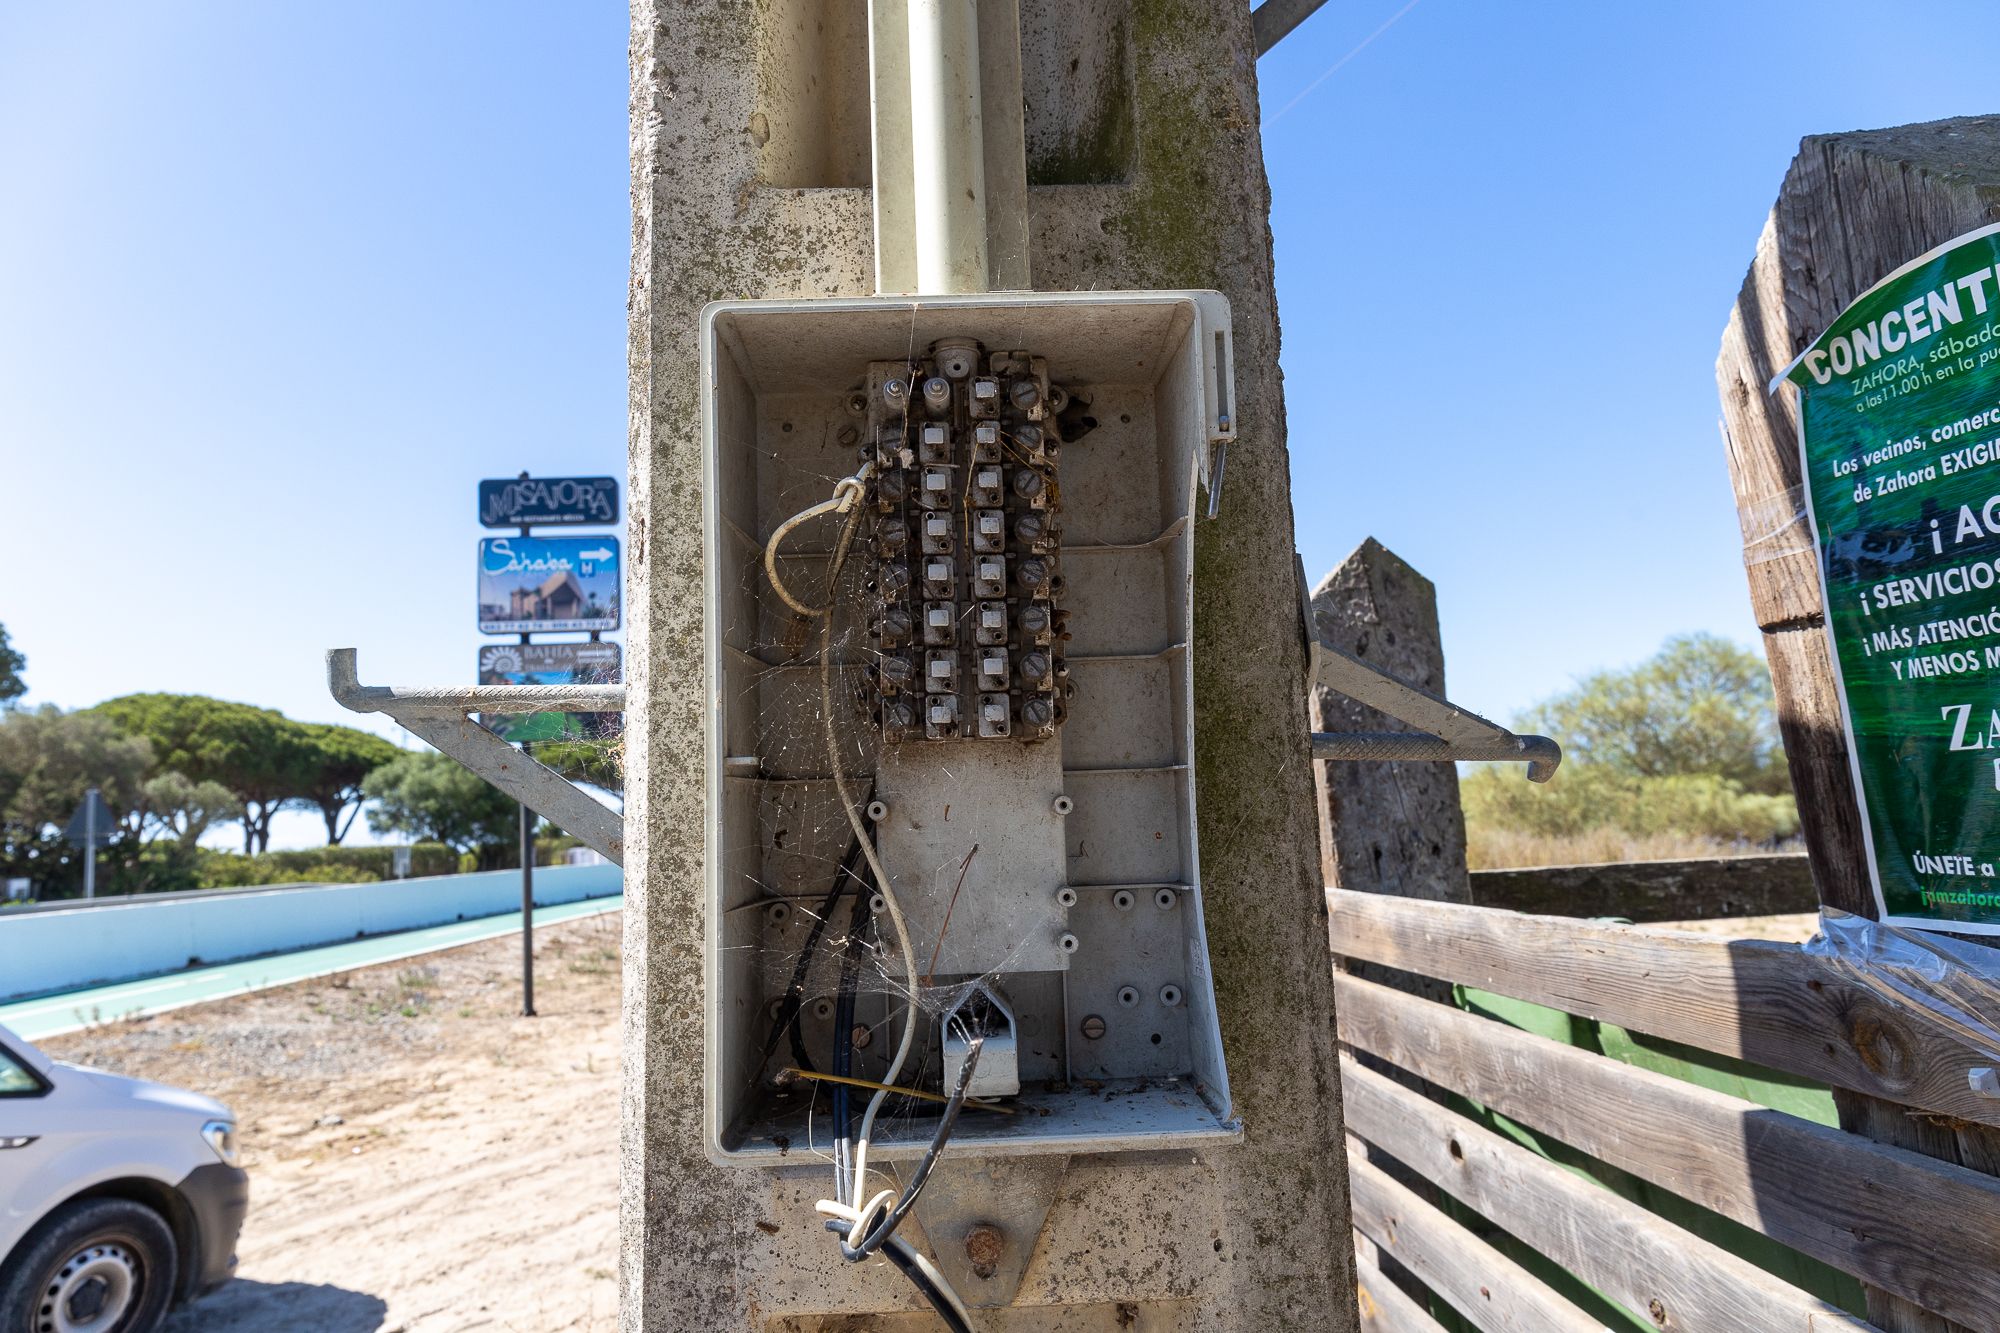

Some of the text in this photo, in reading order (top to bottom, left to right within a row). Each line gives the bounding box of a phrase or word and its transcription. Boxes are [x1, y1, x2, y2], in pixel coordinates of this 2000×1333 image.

[1804, 263, 2000, 385] CONCENT
[1852, 355, 1924, 396] ZAHORA,
[1856, 402, 1864, 413] a
[1922, 371, 1933, 385] h
[1936, 365, 1954, 380] en
[1958, 357, 1975, 371] la
[1980, 346, 2000, 367] pu
[1833, 400, 2000, 478] Los vecinos, comerc
[1853, 483, 1872, 503] de
[1875, 465, 1936, 496] Zahora
[1890, 660, 1902, 680] Y
[1908, 650, 1980, 679] MENOS
[1912, 850, 1995, 877] ÚNETE a
